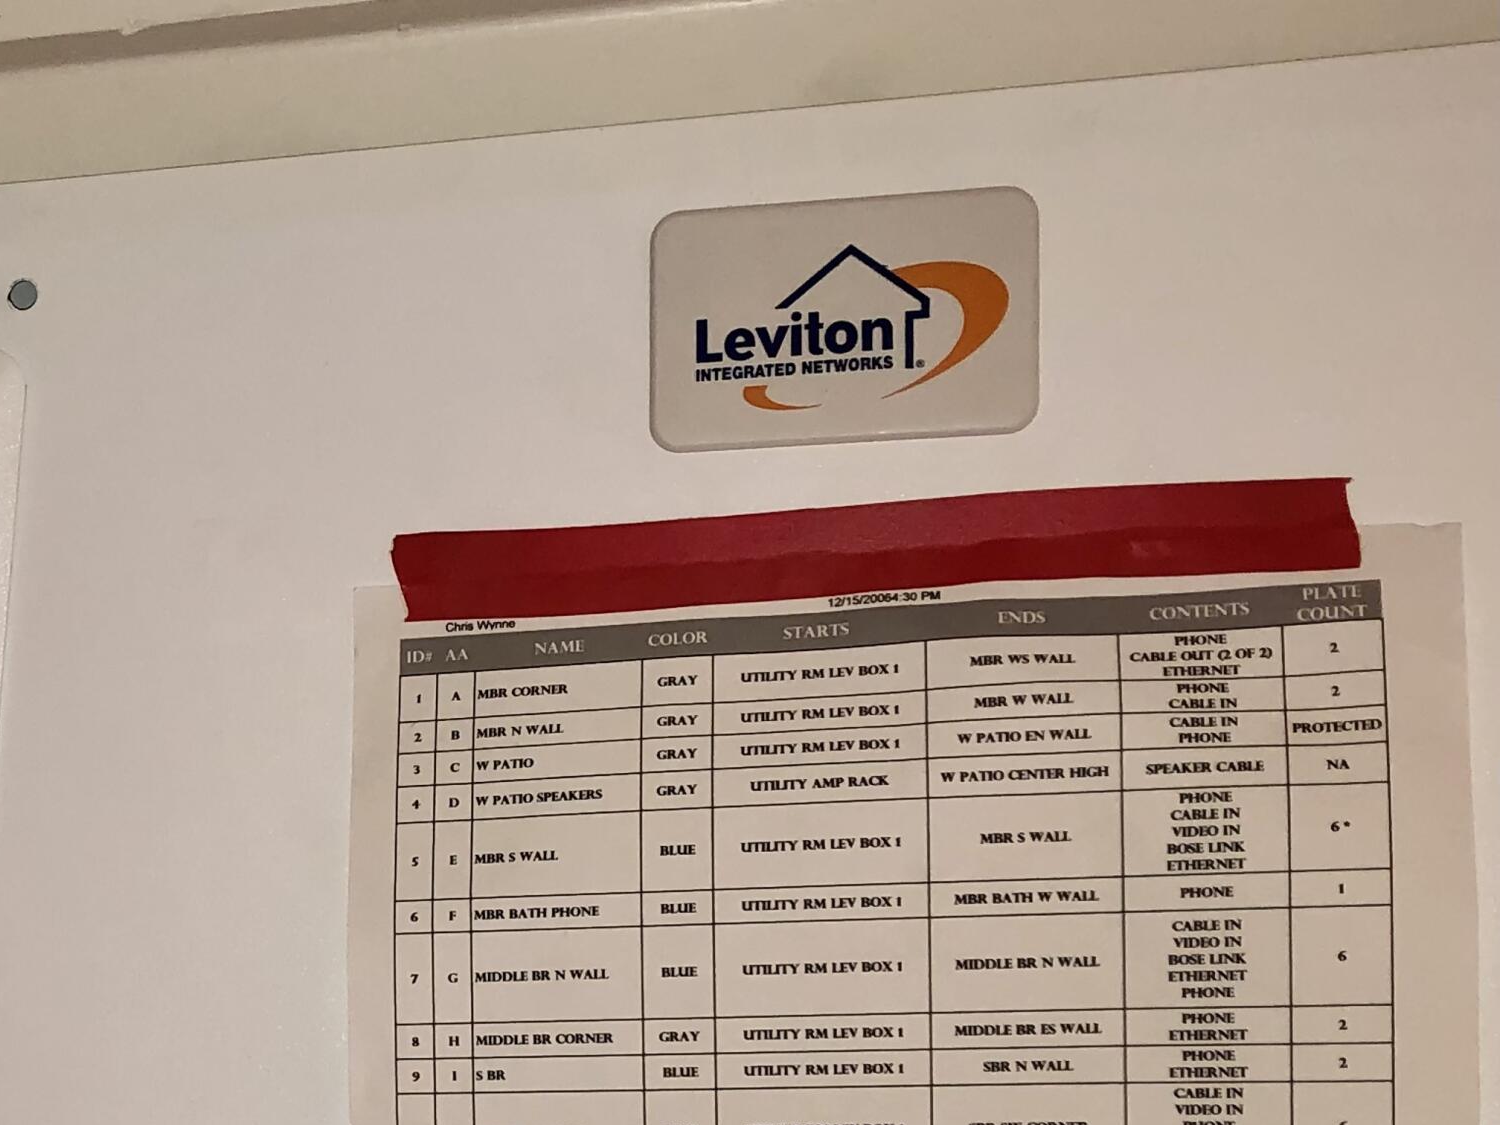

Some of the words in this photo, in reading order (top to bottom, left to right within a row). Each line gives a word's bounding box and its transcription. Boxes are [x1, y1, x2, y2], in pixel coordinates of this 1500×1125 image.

[695, 311, 894, 363] Leviton
[695, 363, 796, 383] INTEGRATED
[801, 356, 894, 375] NETWORKS
[920, 590, 941, 600] PM
[1302, 585, 1360, 600] PLATE
[998, 611, 1045, 623] ENDS
[1149, 602, 1249, 620] CONTENTS
[1297, 604, 1367, 621] COUNT
[445, 618, 474, 632] Chris
[783, 622, 849, 639] STARTS
[648, 631, 707, 646] COLOR
[1174, 633, 1226, 646] PHONE
[535, 640, 583, 654] NAME
[1329, 642, 1339, 653] 2
[407, 650, 432, 663] ID#
[446, 648, 468, 661] AA
[970, 654, 1003, 666] MBR
[1007, 654, 1029, 664] WS
[1033, 653, 1075, 663] WALL
[1129, 651, 1176, 662] CABLE
[1180, 650, 1214, 661] OUT
[1217, 649, 1231, 661] (2
[1234, 648, 1254, 658] OF
[1259, 647, 1272, 659] 2)
[740, 670, 796, 682] UTILITY
[801, 668, 824, 679] RM
[828, 666, 853, 678] LEV
[858, 663, 889, 676] BOX
[893, 663, 898, 673] 1
[1162, 664, 1240, 676] ETHERNET
[657, 674, 697, 686] GRAY
[416, 694, 421, 703] 1
[451, 691, 460, 700] A
[475, 686, 507, 699] MBR
[511, 684, 567, 696] CORNER
[1145, 761, 1211, 775] SPEAKER
[1216, 760, 1264, 772] CABLE
[1326, 759, 1349, 769] NA
[940, 772, 955, 782] W
[959, 769, 1004, 782] PATIO
[1007, 767, 1064, 780] CENTER
[1069, 765, 1109, 778] HIGH
[656, 784, 696, 796] GRAY
[750, 778, 807, 791] UTILITY
[812, 777, 844, 788] AMP
[848, 775, 889, 787] RACK
[449, 797, 459, 807] D
[475, 795, 488, 805] W
[492, 793, 533, 805] PATIO
[536, 788, 602, 802] SPEAKERS
[411, 799, 419, 809] 4
